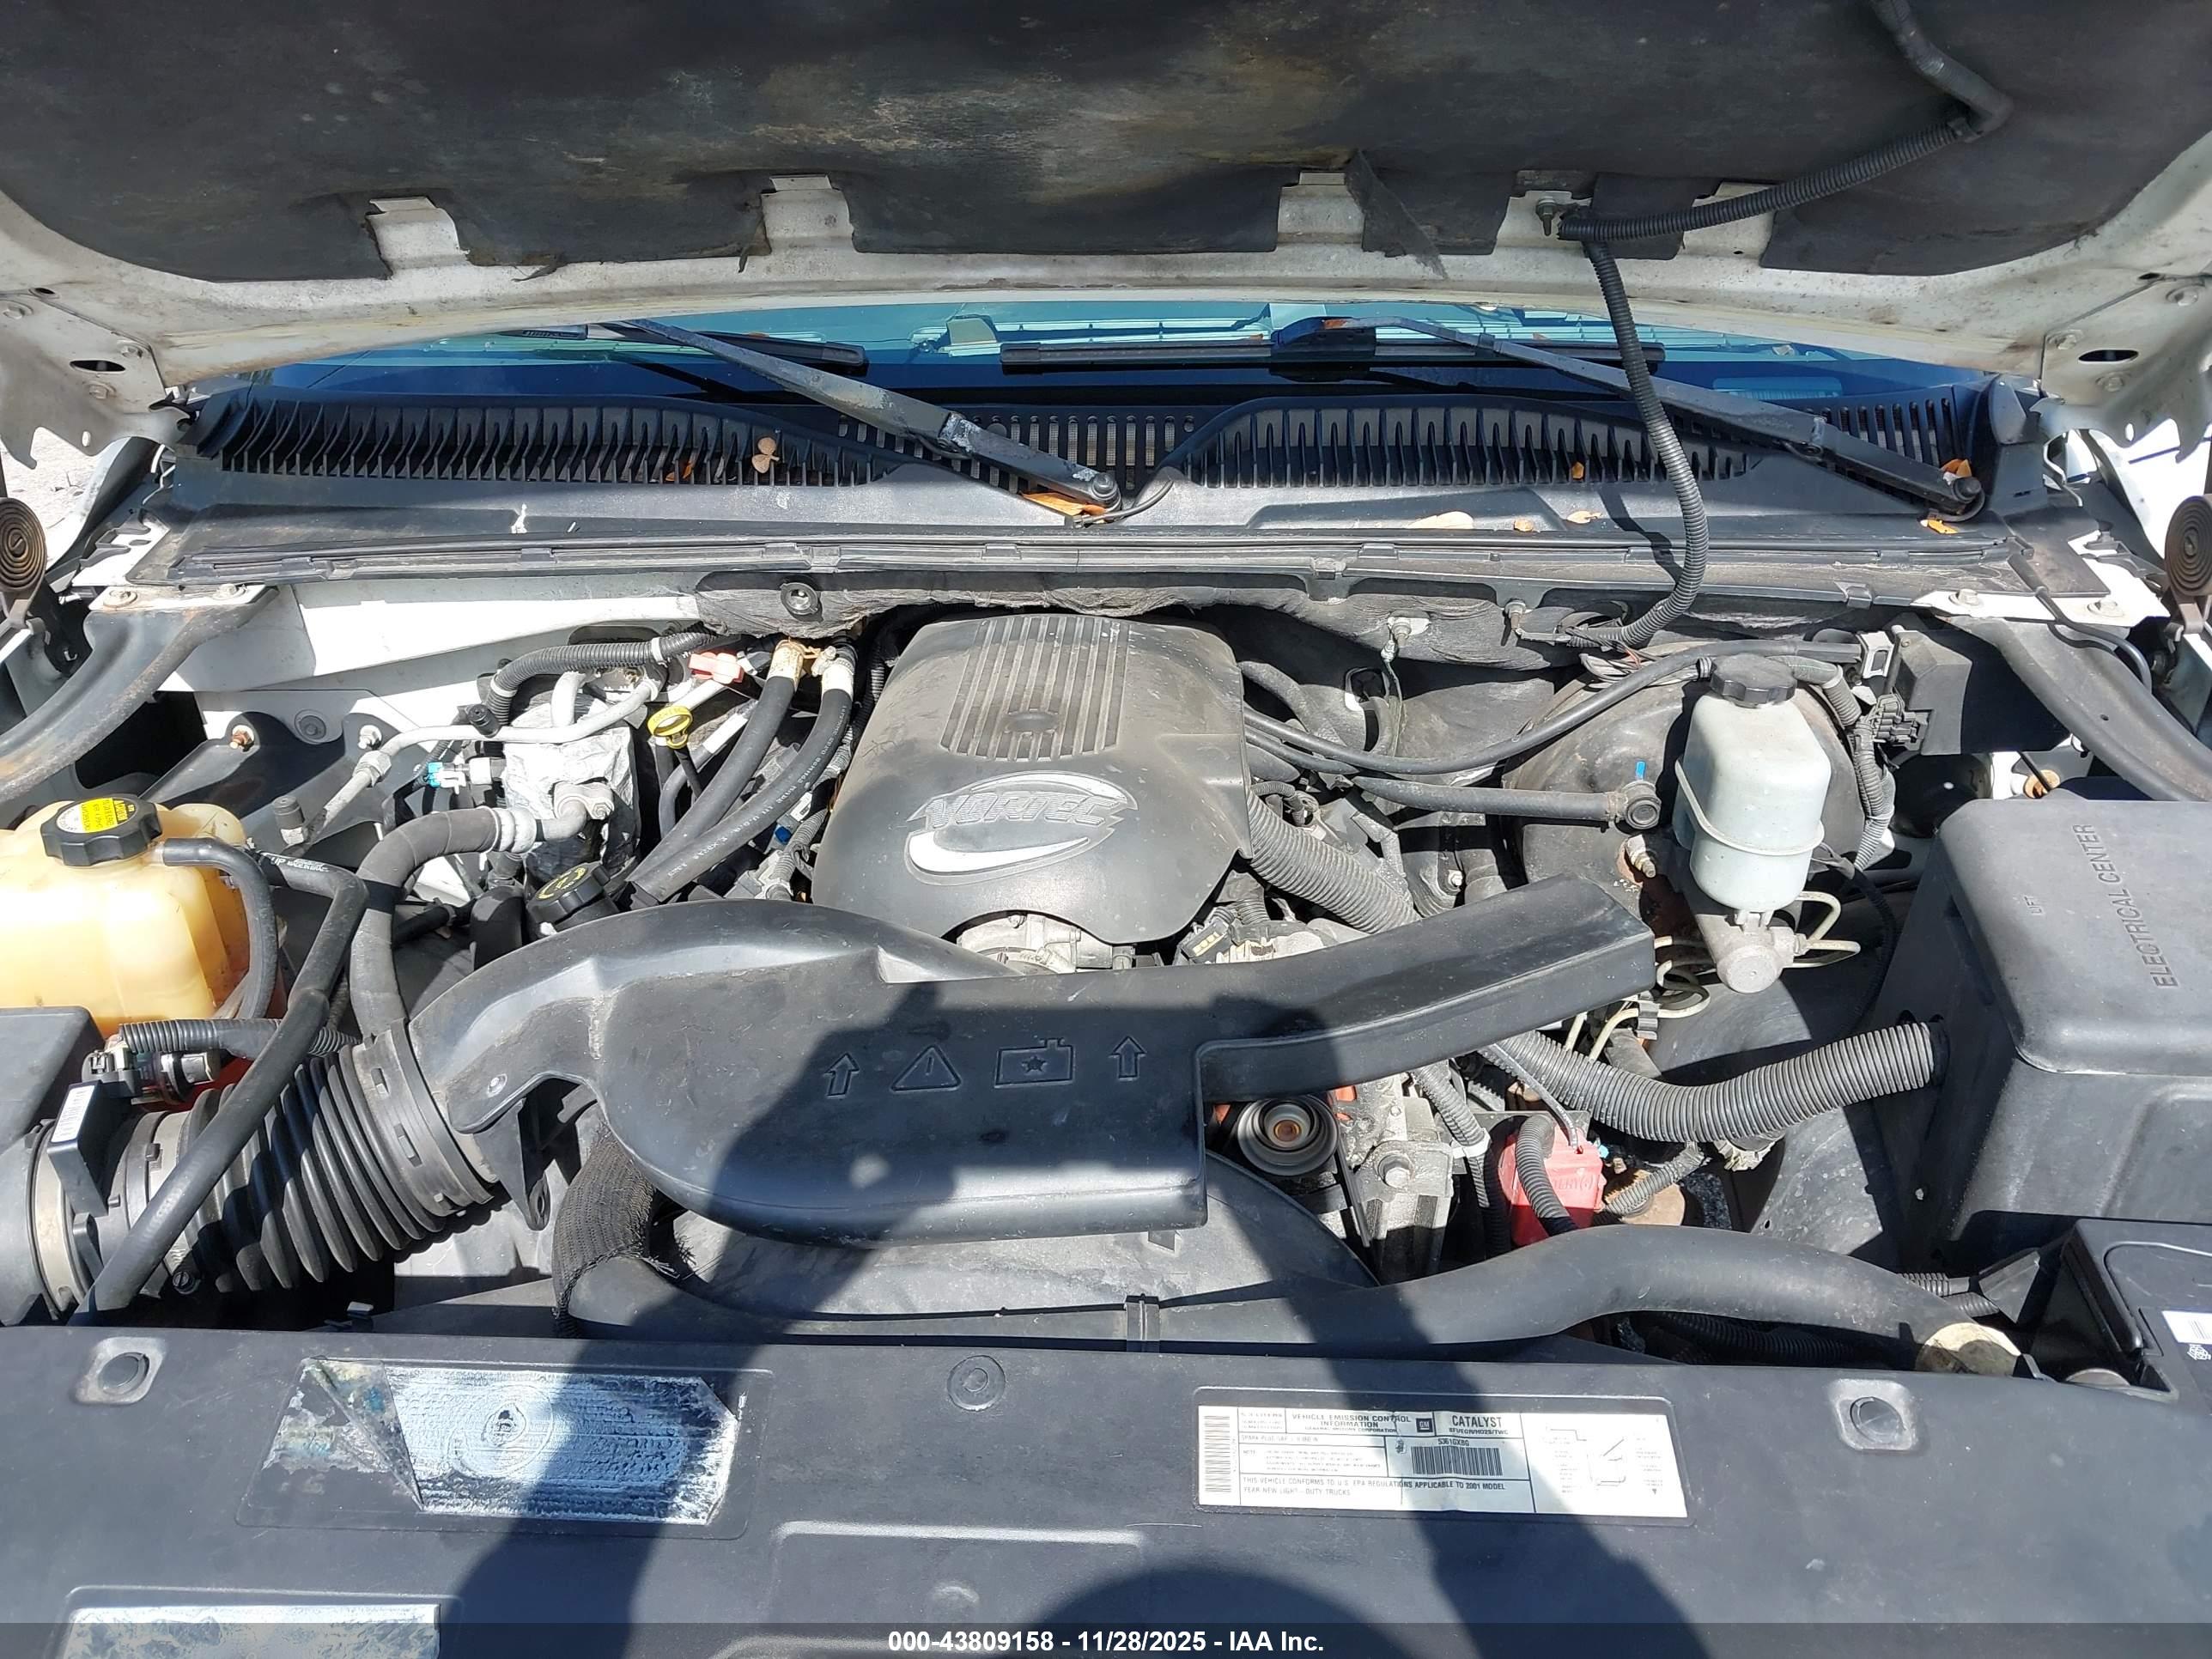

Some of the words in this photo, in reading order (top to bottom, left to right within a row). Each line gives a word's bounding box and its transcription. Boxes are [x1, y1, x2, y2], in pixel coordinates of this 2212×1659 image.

[926, 791, 1120, 829] VORTEC
[2072, 824, 2121, 884] CENTER
[2108, 888, 2179, 987] ELECTRICAL
[1452, 1414, 1502, 1428] CATALYST
[1260, 1477, 1285, 1486] VEHICLE
[1288, 1478, 1324, 1486] CONFORMS
[1367, 1480, 1413, 1489] REGULATIONS
[1415, 1480, 1453, 1489] APPLICABLE
[1455, 1481, 1464, 1490] TO
[1262, 1486, 1277, 1495] NEW
[1326, 1488, 1351, 1497] TRUCKS
